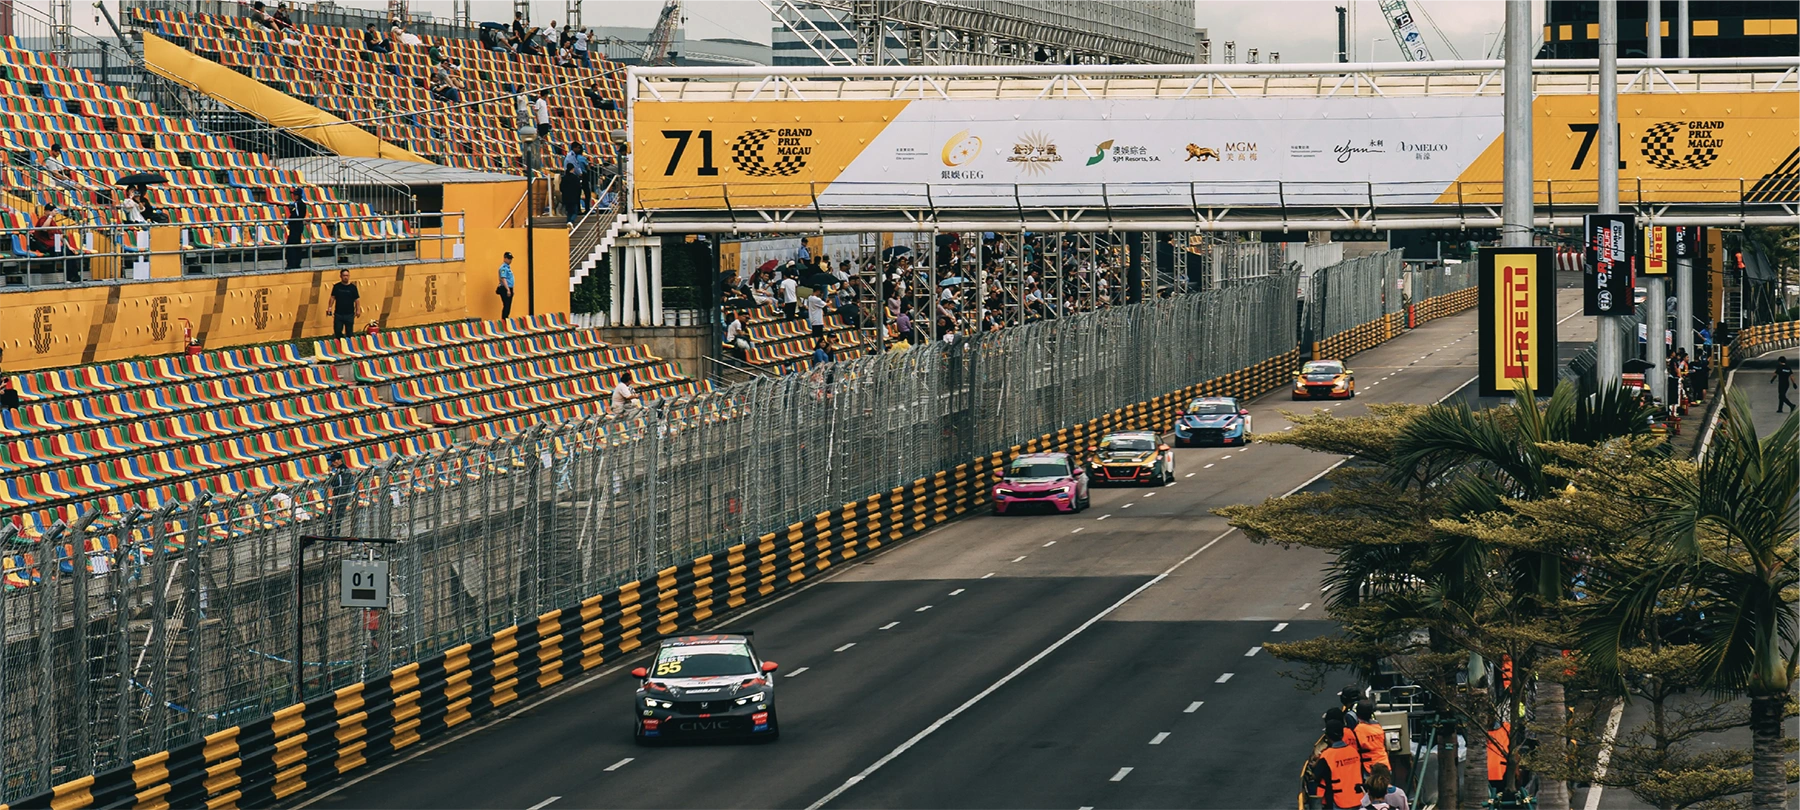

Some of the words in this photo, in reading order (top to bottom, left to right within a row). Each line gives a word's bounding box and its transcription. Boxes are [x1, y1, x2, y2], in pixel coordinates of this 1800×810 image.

[1416, 49, 1426, 60] 2
[1688, 121, 1724, 129] GRAND
[777, 128, 812, 137] GRAND
[1688, 130, 1712, 138] PRIX
[778, 138, 800, 146] PRIX
[1225, 141, 1258, 152] MGM
[1415, 143, 1448, 152] MELCO
[1688, 139, 1724, 148] MACAU
[660, 130, 719, 176] 71
[777, 147, 812, 155] MACAU
[1597, 262, 1607, 289] TCR
[1601, 292, 1610, 309] FIA
[1504, 266, 1529, 378] PIRELLI
[657, 661, 682, 676] 55
[680, 720, 730, 731] CIVIC
